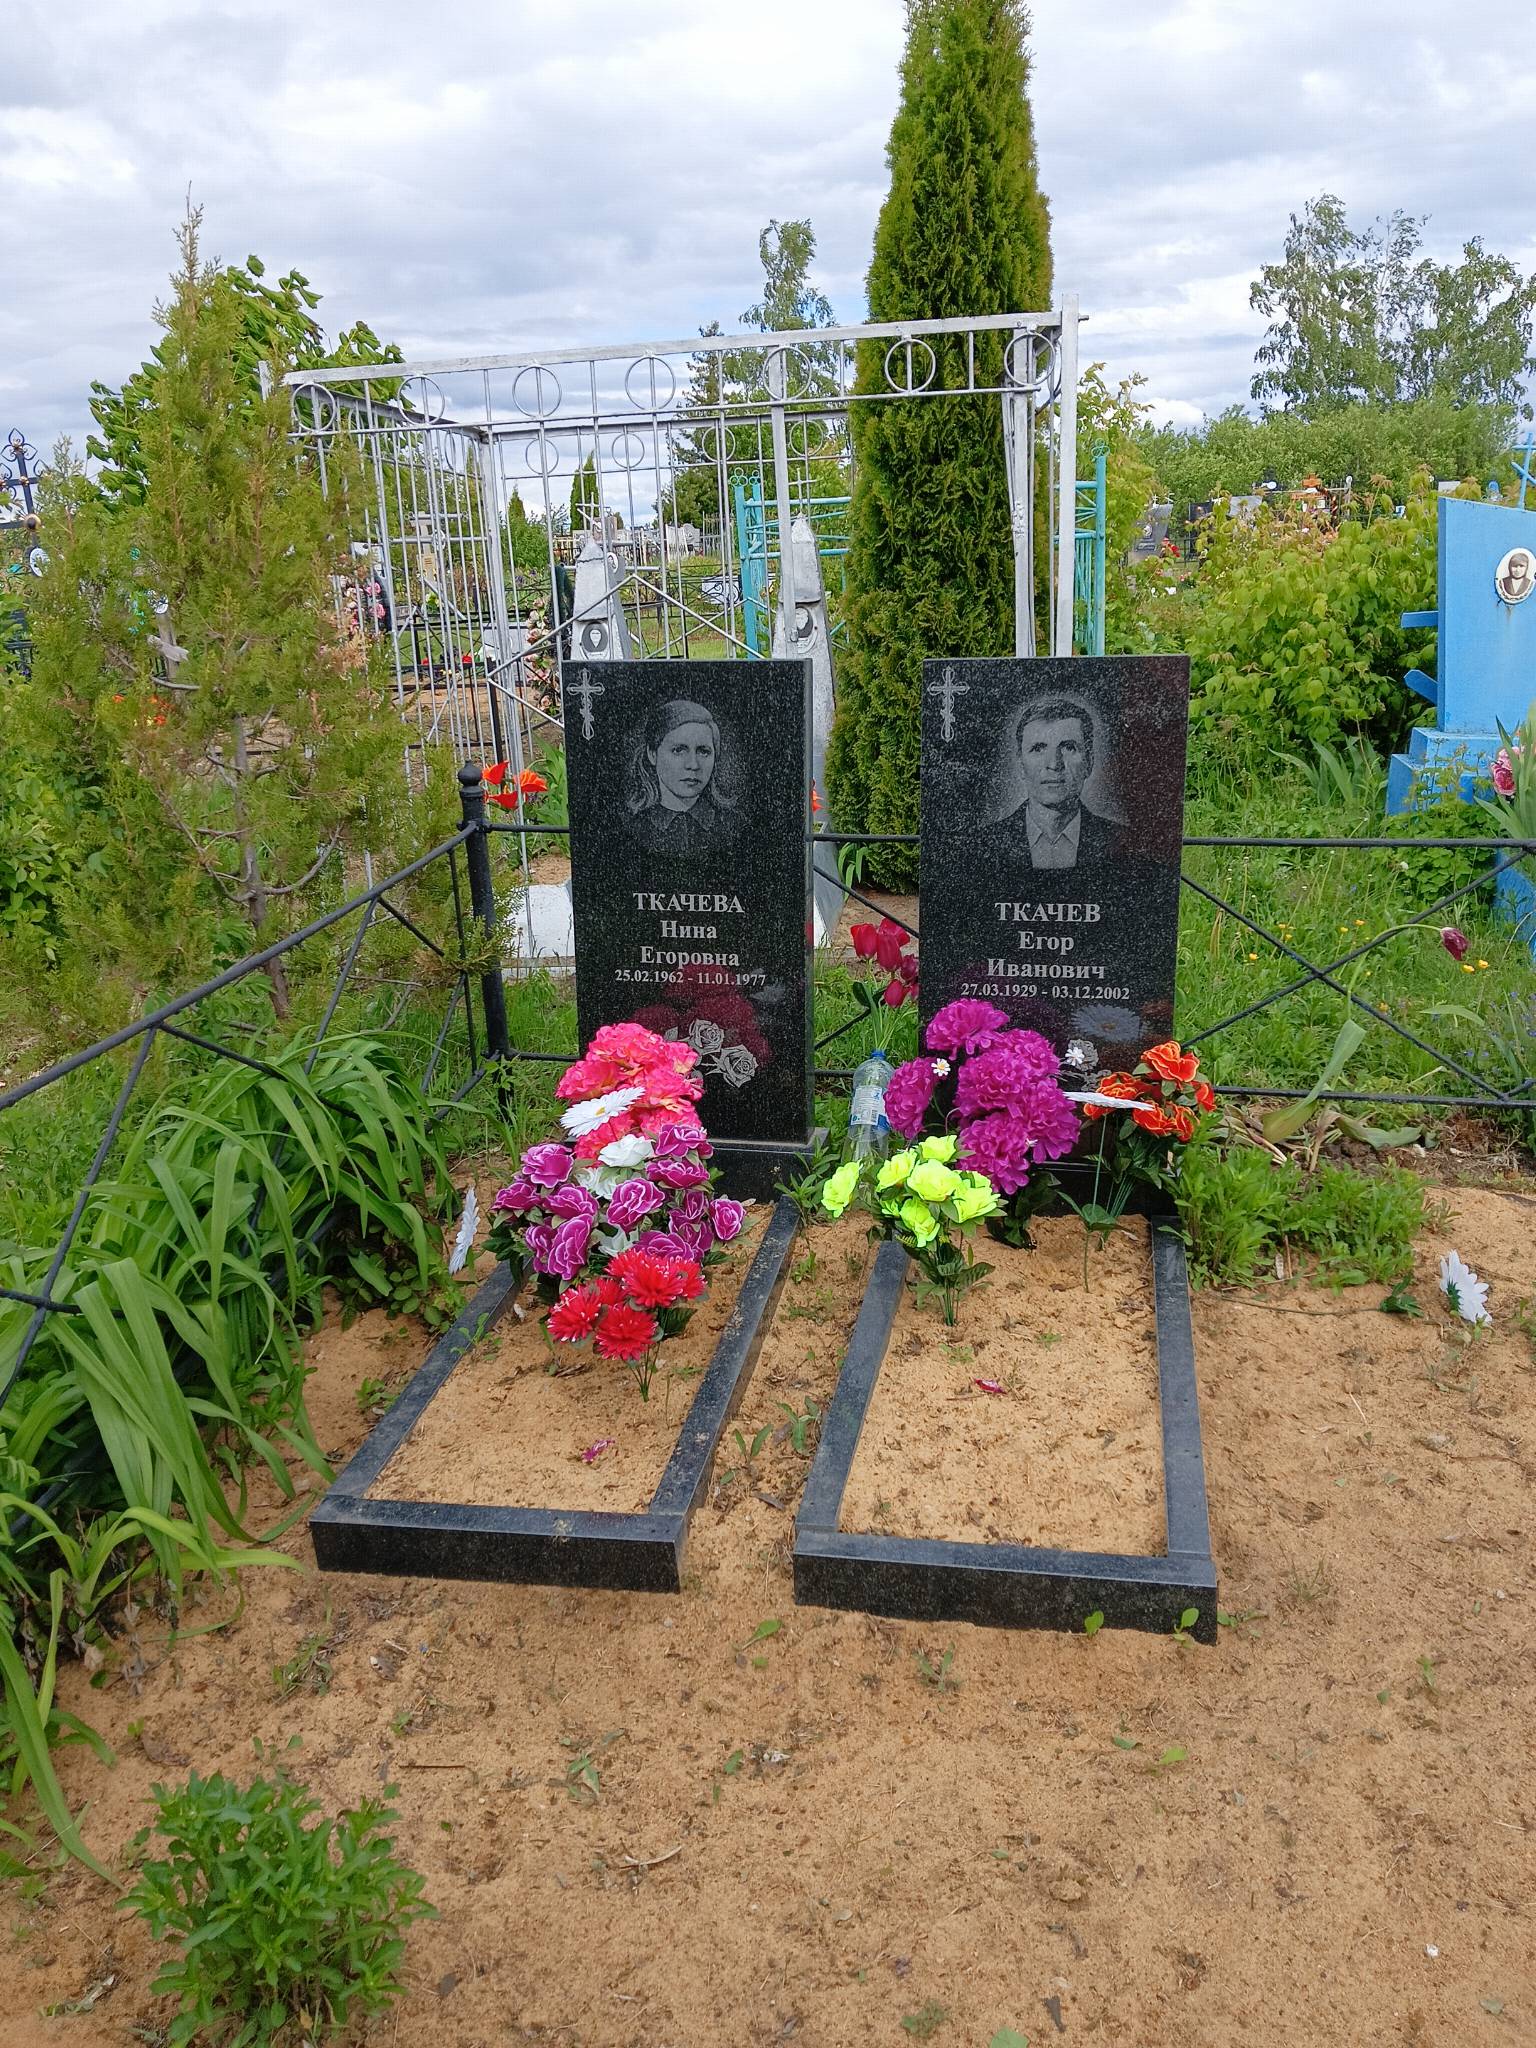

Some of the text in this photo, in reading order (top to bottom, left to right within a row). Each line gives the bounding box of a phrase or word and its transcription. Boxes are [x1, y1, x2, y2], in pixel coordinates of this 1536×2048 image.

[632, 892, 745, 913] ТКАЧЕВА
[994, 902, 1101, 923] ТКАЧЕВ
[660, 919, 718, 939] Нина
[1017, 930, 1075, 956] Егор
[639, 945, 740, 969] Егоровна
[614, 969, 684, 983] 25.02.1962
[697, 972, 766, 986] 11.01.1977
[986, 958, 1105, 979] Иванович
[960, 982, 1038, 997] 27.03.1929
[1052, 985, 1130, 1000] 03.12.2002
